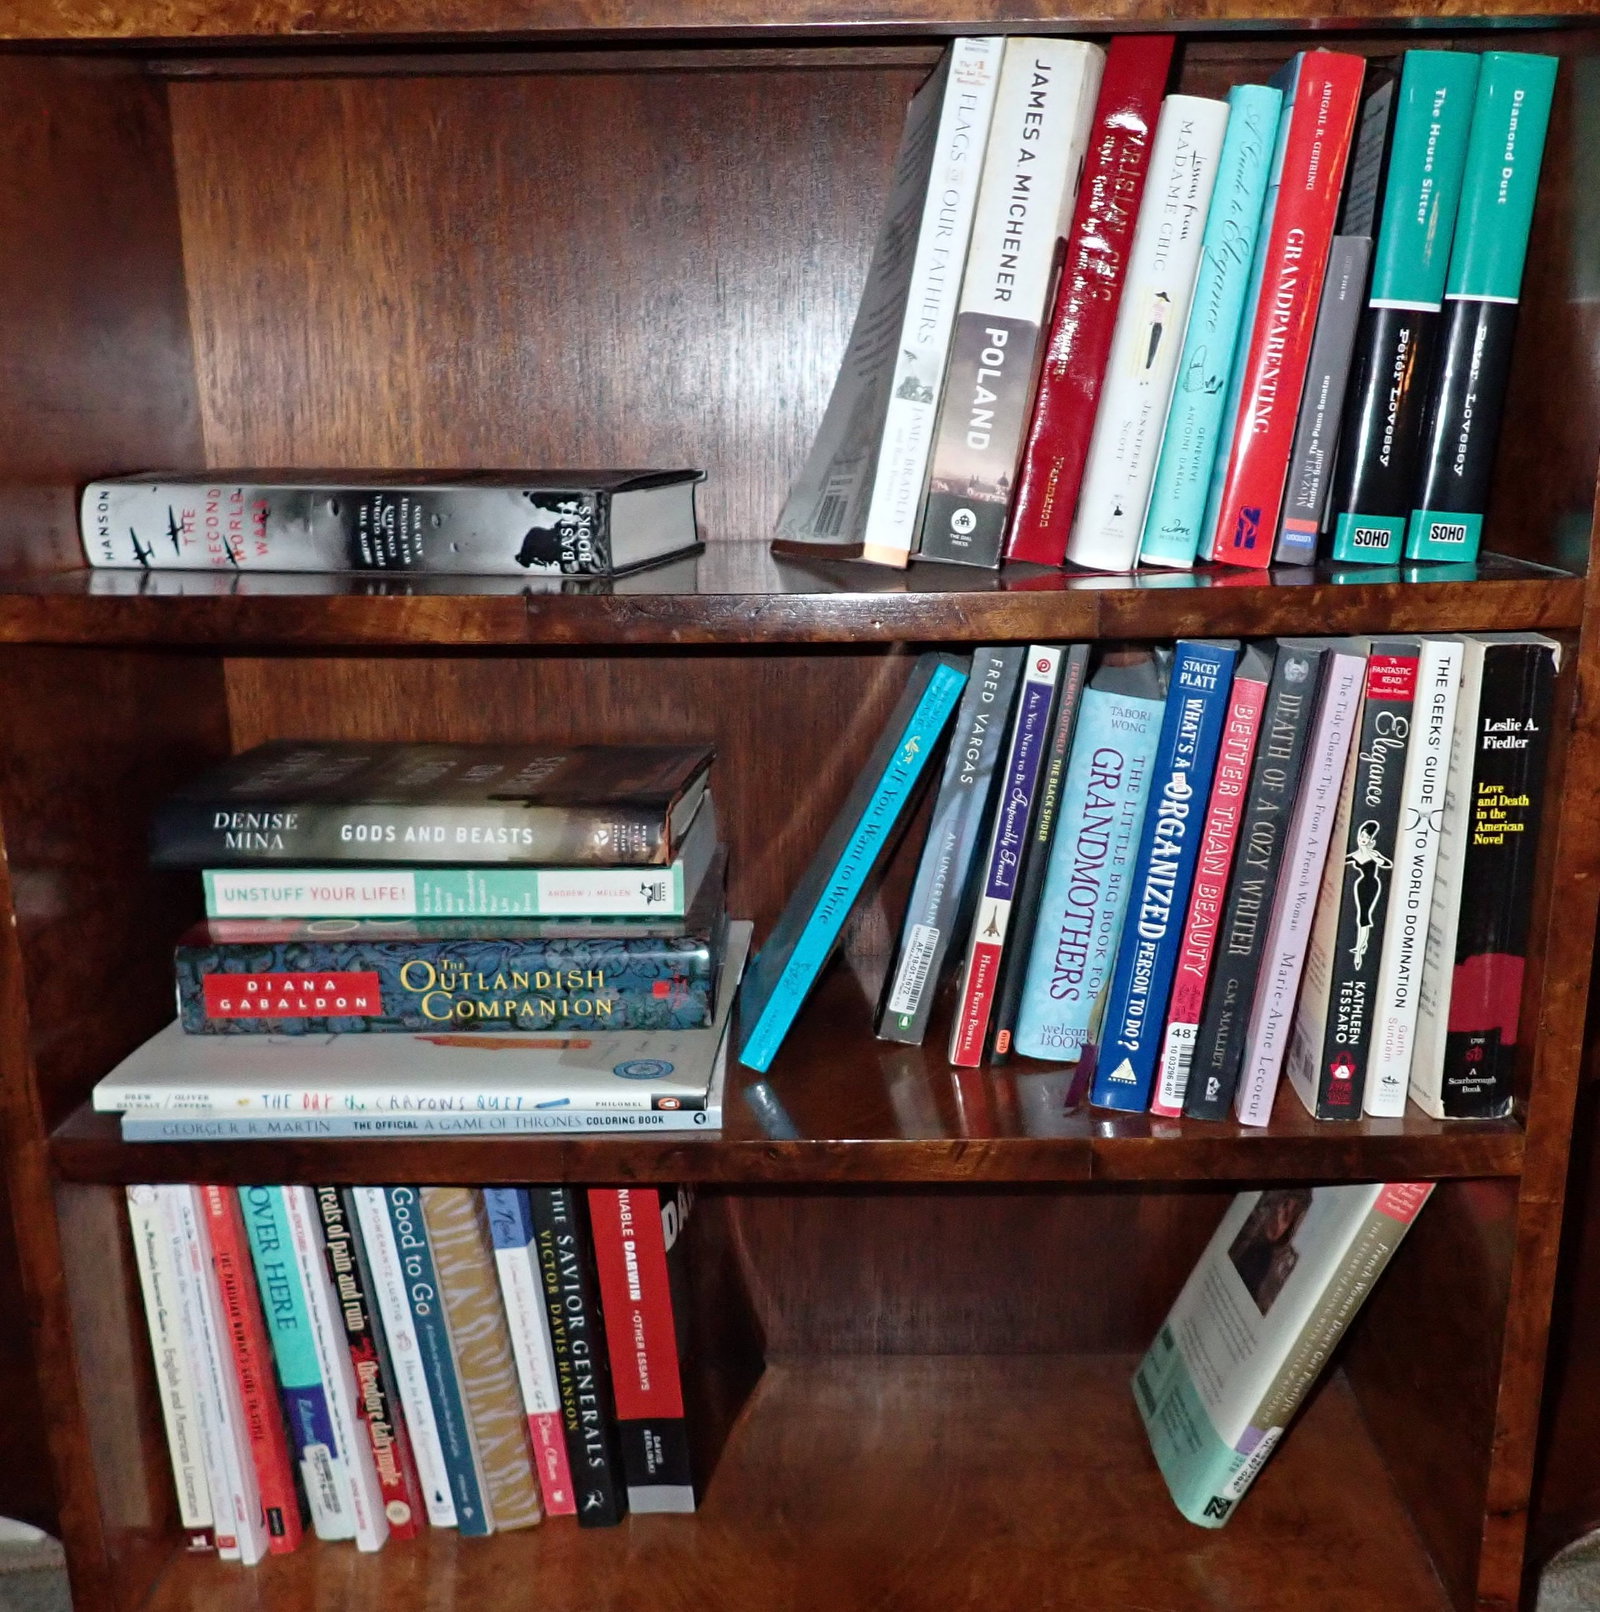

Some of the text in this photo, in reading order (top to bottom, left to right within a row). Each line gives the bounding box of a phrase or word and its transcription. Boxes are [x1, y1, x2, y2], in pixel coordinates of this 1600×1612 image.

[948, 92, 978, 162] FLAGS
[1304, 81, 1335, 192] ABIGAIL GEHRING
[1416, 87, 1447, 225] The House Sitter
[1496, 89, 1525, 205] Diamond Dust
[993, 58, 1052, 304] JAMES MICHENER
[1152, 119, 1195, 273] MADAME CHIC
[938, 189, 962, 239] OUR
[916, 246, 954, 345] FATHERS
[1203, 216, 1251, 336] Elegance
[1253, 228, 1306, 435] GRANDPARENTING
[965, 326, 1010, 452] POLAND
[1379, 327, 1411, 468] Peter Lovesey
[1311, 411, 1325, 439] Piano
[1453, 393, 1477, 477] Lovesey
[414, 504, 422, 530] WON
[1039, 455, 1066, 528] Flammarion
[97, 490, 114, 561] HANSON
[182, 508, 196, 545] THE
[205, 488, 227, 566] SECOND
[373, 494, 386, 567] FIRST GLOBAL
[576, 504, 593, 563] BOOKS
[1354, 529, 1391, 548] SOHO
[1430, 524, 1466, 542] SOHO
[1179, 672, 1217, 690] PLATT
[1182, 660, 1220, 676] STACEY
[1371, 665, 1413, 676] FANTASTIC
[960, 658, 1004, 785] FRED VARGAS
[1110, 704, 1152, 722] TABORI
[1111, 718, 1147, 735] WONG
[1483, 736, 1530, 750] Fiedler
[1484, 717, 1540, 732] Leslie A.
[1038, 661, 1081, 842] JEREMIAS THE BLACK SPIDER
[1218, 703, 1258, 797] BETTER
[1359, 709, 1410, 809] Elegance
[1288, 674, 1354, 933] The Tidy Tips From A French Woman
[1476, 808, 1507, 820] in the
[1477, 795, 1530, 807] and Death
[1478, 782, 1505, 795] Love
[213, 811, 300, 830] DENISE
[225, 831, 285, 850] MINA
[340, 823, 535, 845] GODS AND BEASTS
[1202, 805, 1235, 877] THAN
[1229, 691, 1303, 957] DEATH OF COZY WRITER
[1394, 656, 1452, 1010] THE GEEKS' GUIDE TO WORLD DOMINATION
[1473, 834, 1505, 845] Novel
[1475, 821, 1525, 833] American
[818, 787, 899, 926] You Write
[927, 833, 957, 926] AN UNCERTAIN
[1050, 747, 1124, 1002] GRANDMOTHERS
[1086, 755, 1146, 1000] THE LITTLE BIG BOOK FOR
[1128, 698, 1204, 1016] WHAT'S A ORGANIZED PERSON TO
[223, 886, 407, 902] UNSTUFF YOUR LIFE!
[547, 890, 632, 898] ANDREW MELLEN
[1183, 883, 1220, 978] BEAUTY
[246, 978, 338, 992] DIANA
[400, 959, 606, 992] OUTLANDISH
[902, 941, 925, 996] AF-18-01-1672
[219, 996, 368, 1011] GABALDON
[420, 991, 614, 1022] COMPANION
[1335, 979, 1354, 1044] TESSARO
[1347, 980, 1368, 1045] KATHLEEN
[1172, 1029, 1198, 1039] 487
[1212, 1010, 1234, 1069] MALLIET
[1248, 952, 1297, 1119] Marie-Anne Lecoeur
[1395, 1024, 1408, 1057] Garth
[124, 1093, 152, 1101] DREW
[1167, 1056, 1177, 1081] 03296
[1447, 1075, 1498, 1086] Scarborough
[1461, 1084, 1482, 1094] Book
[116, 1102, 161, 1110] DAYWALT
[162, 1120, 332, 1137] GEORGE MARTIN
[261, 1094, 524, 1112] THE CRAYONS QUIT
[353, 1114, 665, 1131] THE OFFICIAL A GAME OF THRONES COLORING BOOK
[248, 1186, 299, 1331] OVER HERE
[392, 1187, 435, 1317] Good to Go
[622, 1240, 642, 1302] DARWIN
[1338, 1242, 1390, 1318] French Women
[327, 1239, 369, 1332] pain and ruin
[539, 1229, 581, 1432] VICTOR DAVIS HANSON
[551, 1188, 606, 1469] THE SAVIOR GENERALS
[357, 1361, 402, 1487] theodore dalrymple
[652, 1434, 664, 1465] DAVID
